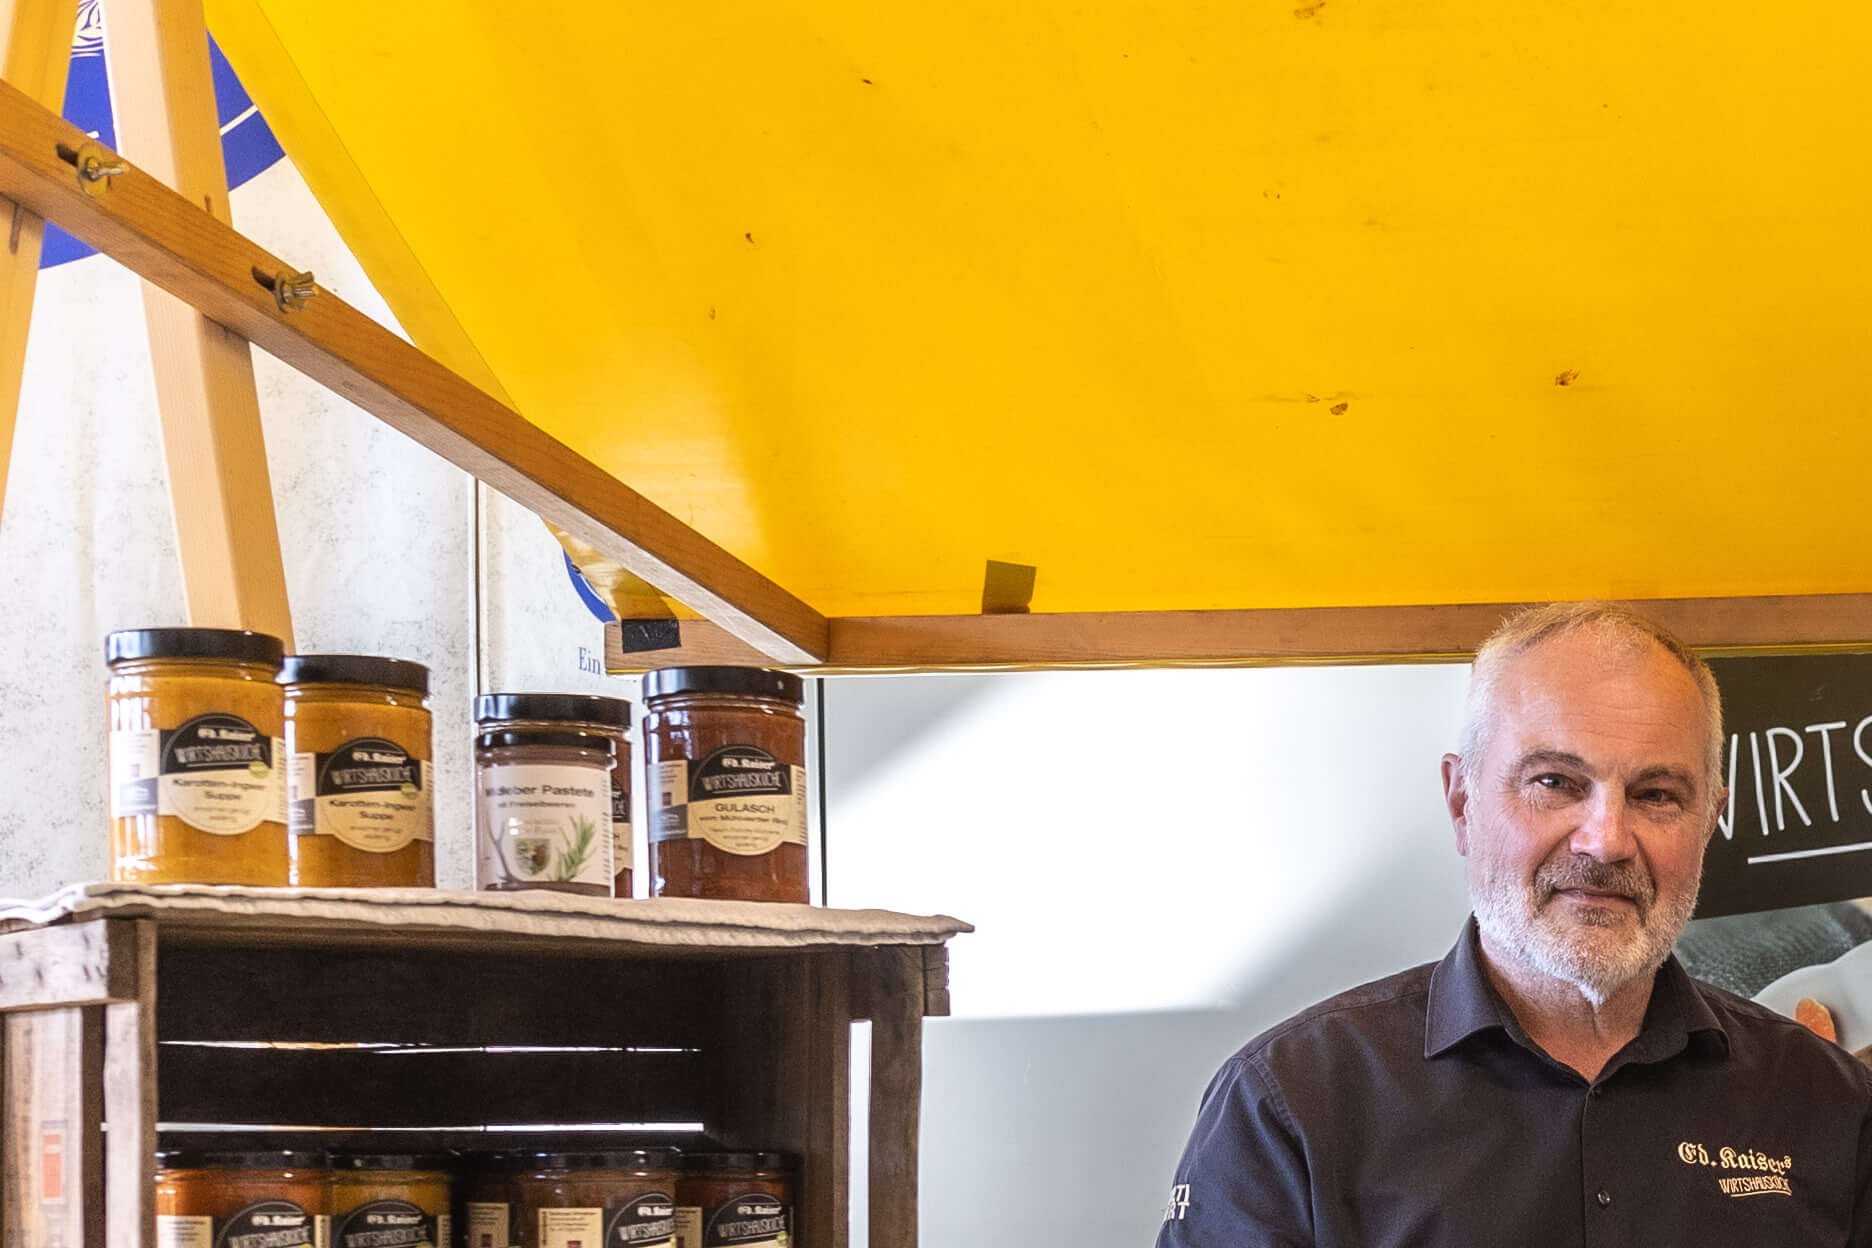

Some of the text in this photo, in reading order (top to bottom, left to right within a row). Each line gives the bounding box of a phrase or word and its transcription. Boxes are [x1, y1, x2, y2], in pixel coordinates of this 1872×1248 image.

[542, 785, 595, 798] Pastete
[715, 803, 775, 815] GULASCH
[1678, 1142, 1718, 1167] Ed.
